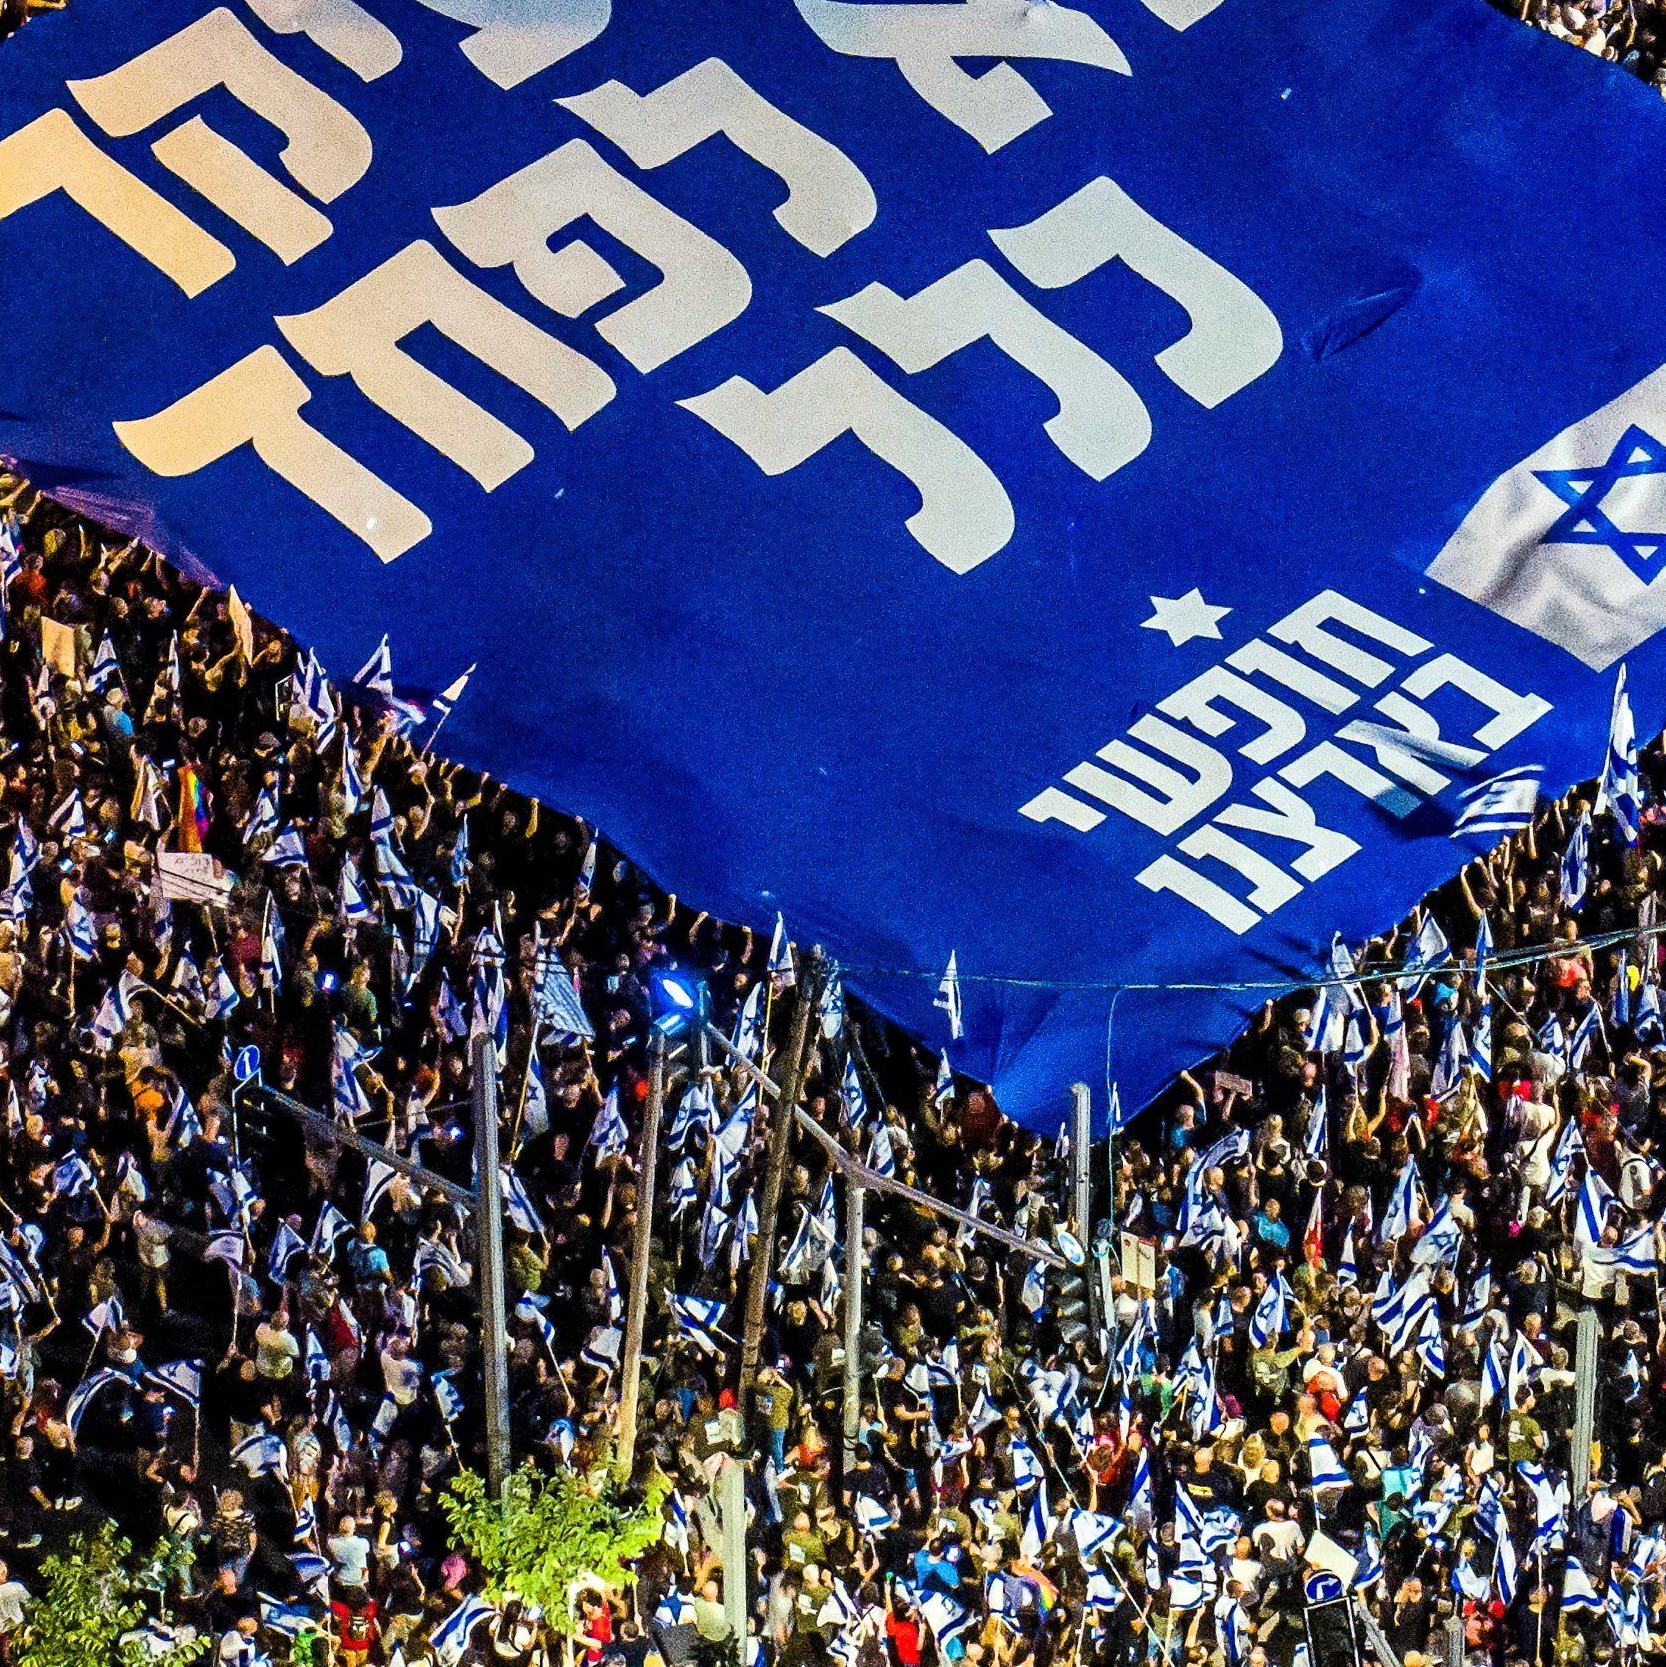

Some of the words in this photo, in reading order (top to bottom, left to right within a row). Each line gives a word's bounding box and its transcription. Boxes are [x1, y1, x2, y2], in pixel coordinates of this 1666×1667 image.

[113, 56, 878, 564] לפחד
[678, 175, 1284, 576] כלל
[1017, 589, 1435, 836] חופשי
[1134, 651, 1554, 935] בארצנו
